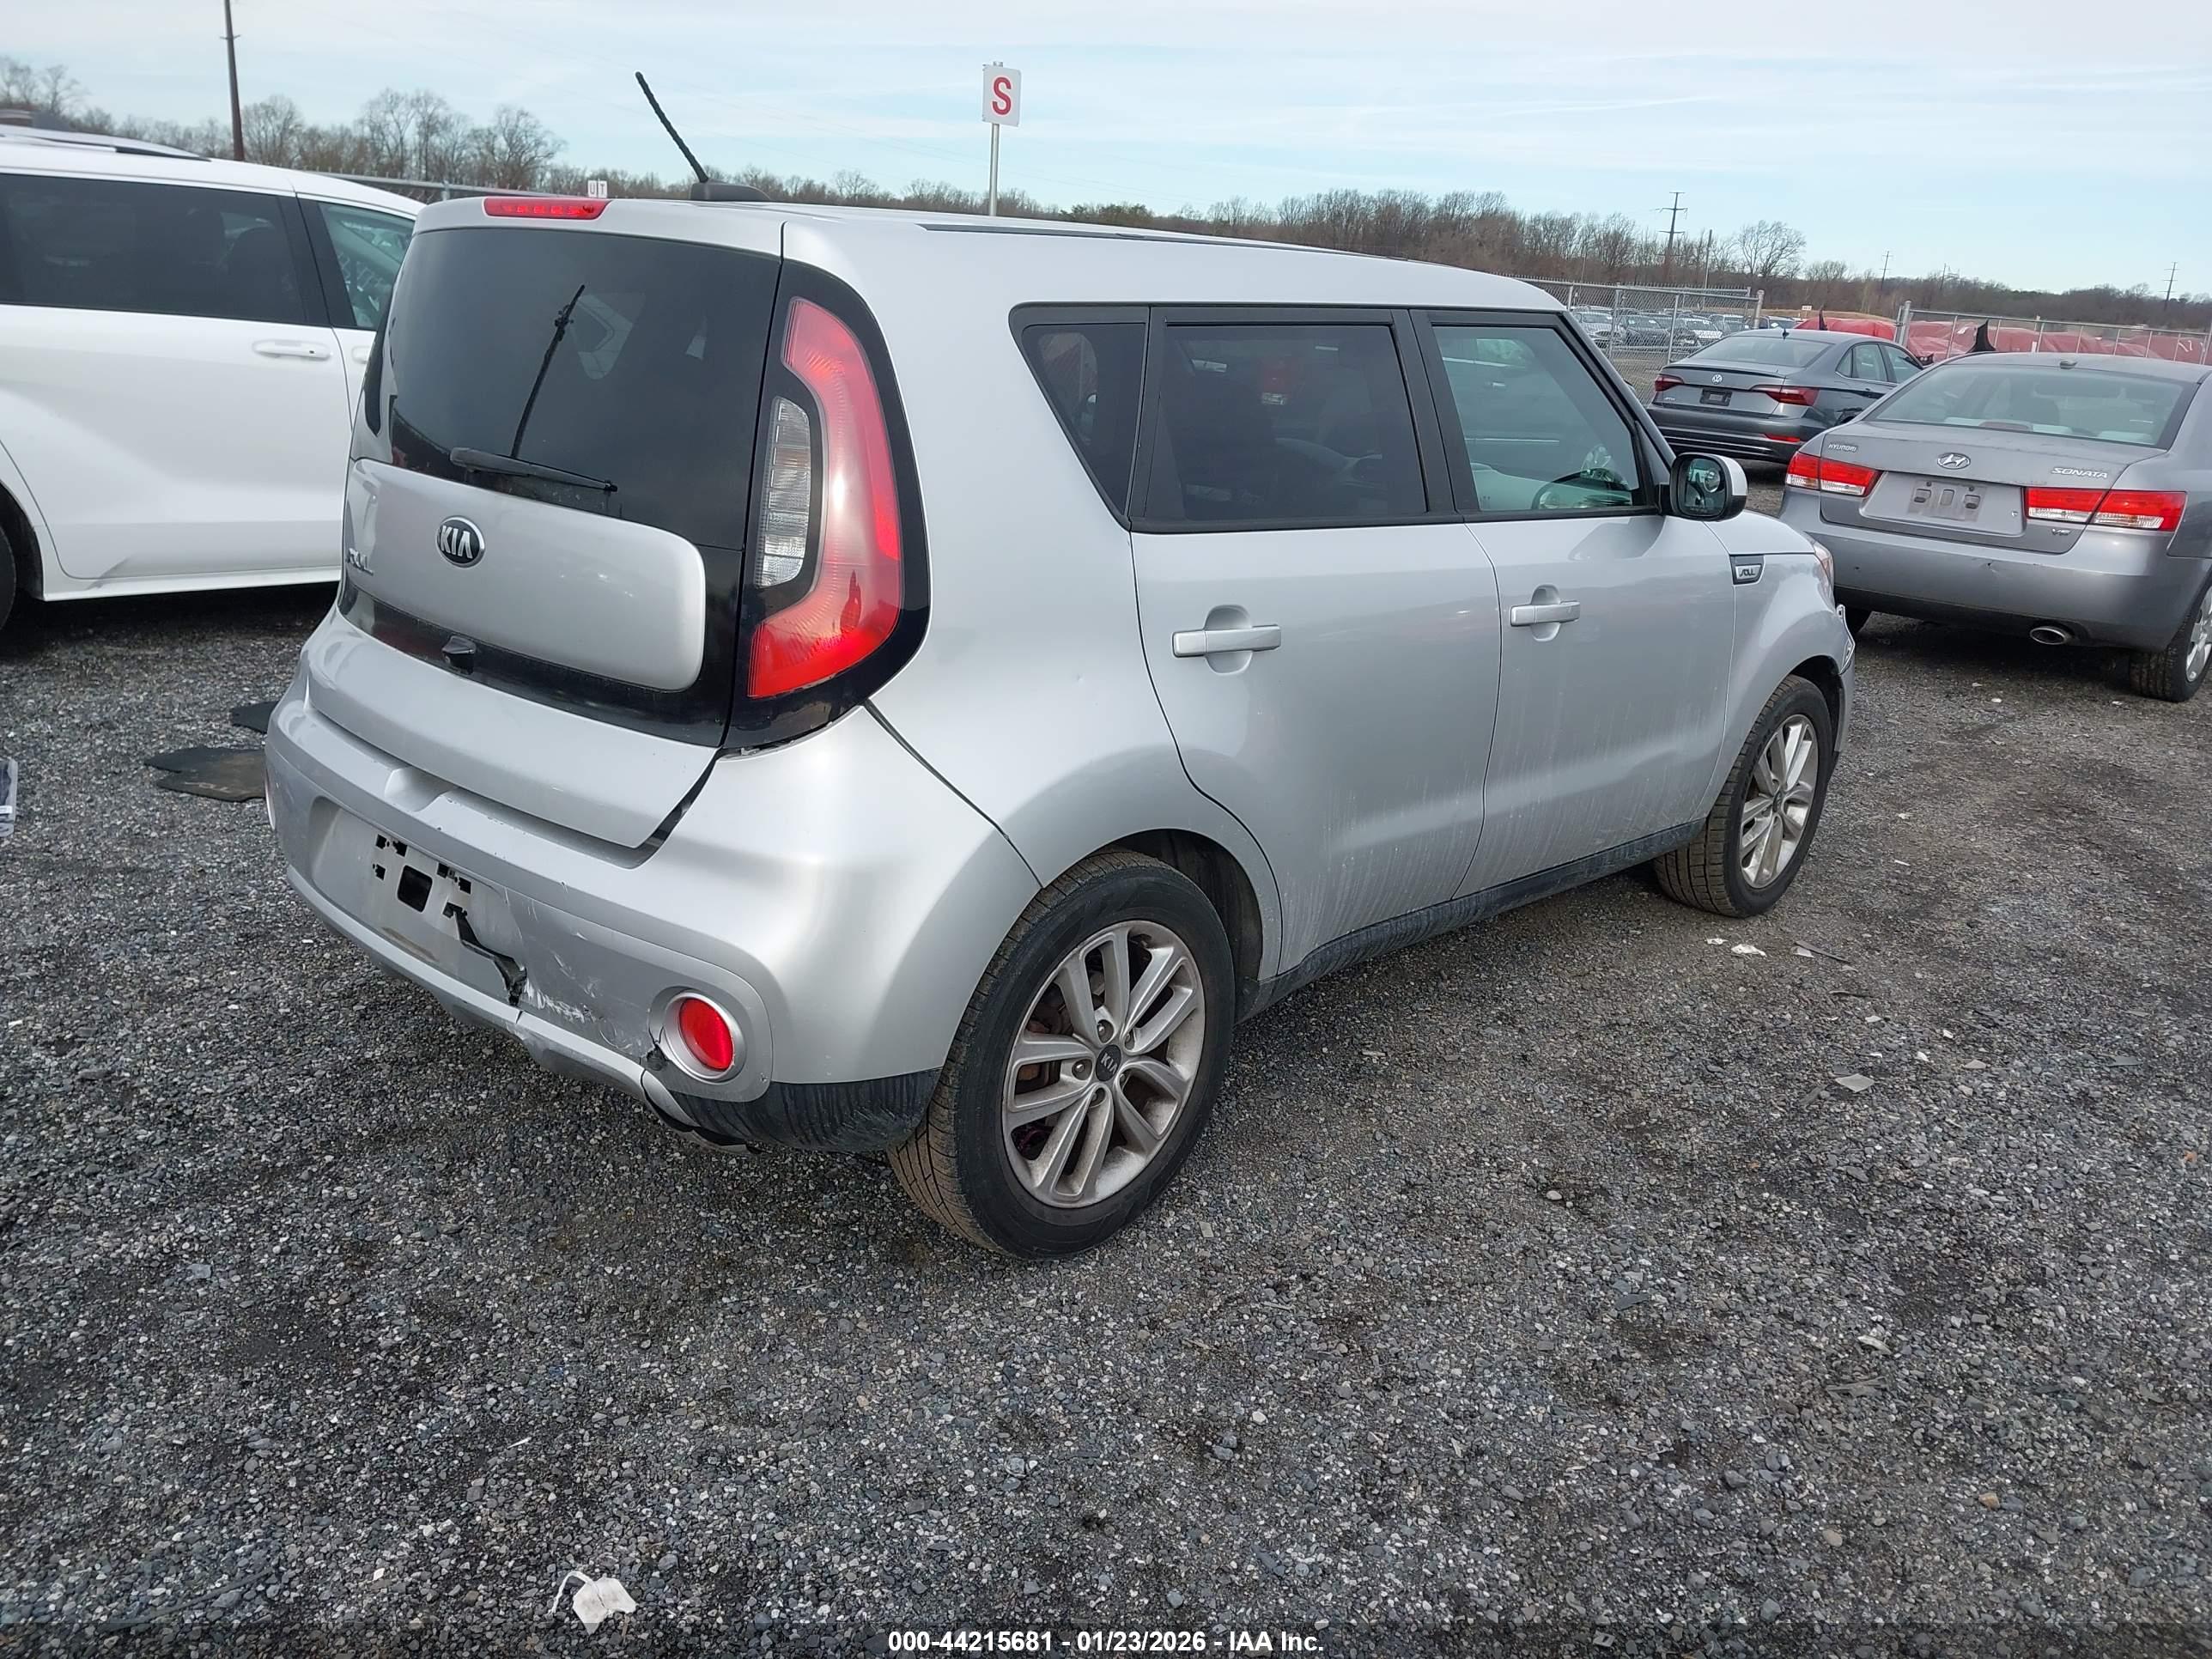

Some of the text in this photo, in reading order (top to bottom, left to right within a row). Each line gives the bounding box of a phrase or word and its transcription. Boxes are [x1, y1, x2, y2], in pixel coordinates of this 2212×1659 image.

[992, 76, 1012, 116] S
[2051, 467, 2108, 478] SONATA
[440, 525, 473, 559] KIA
[1100, 1051, 1118, 1075] KIA
